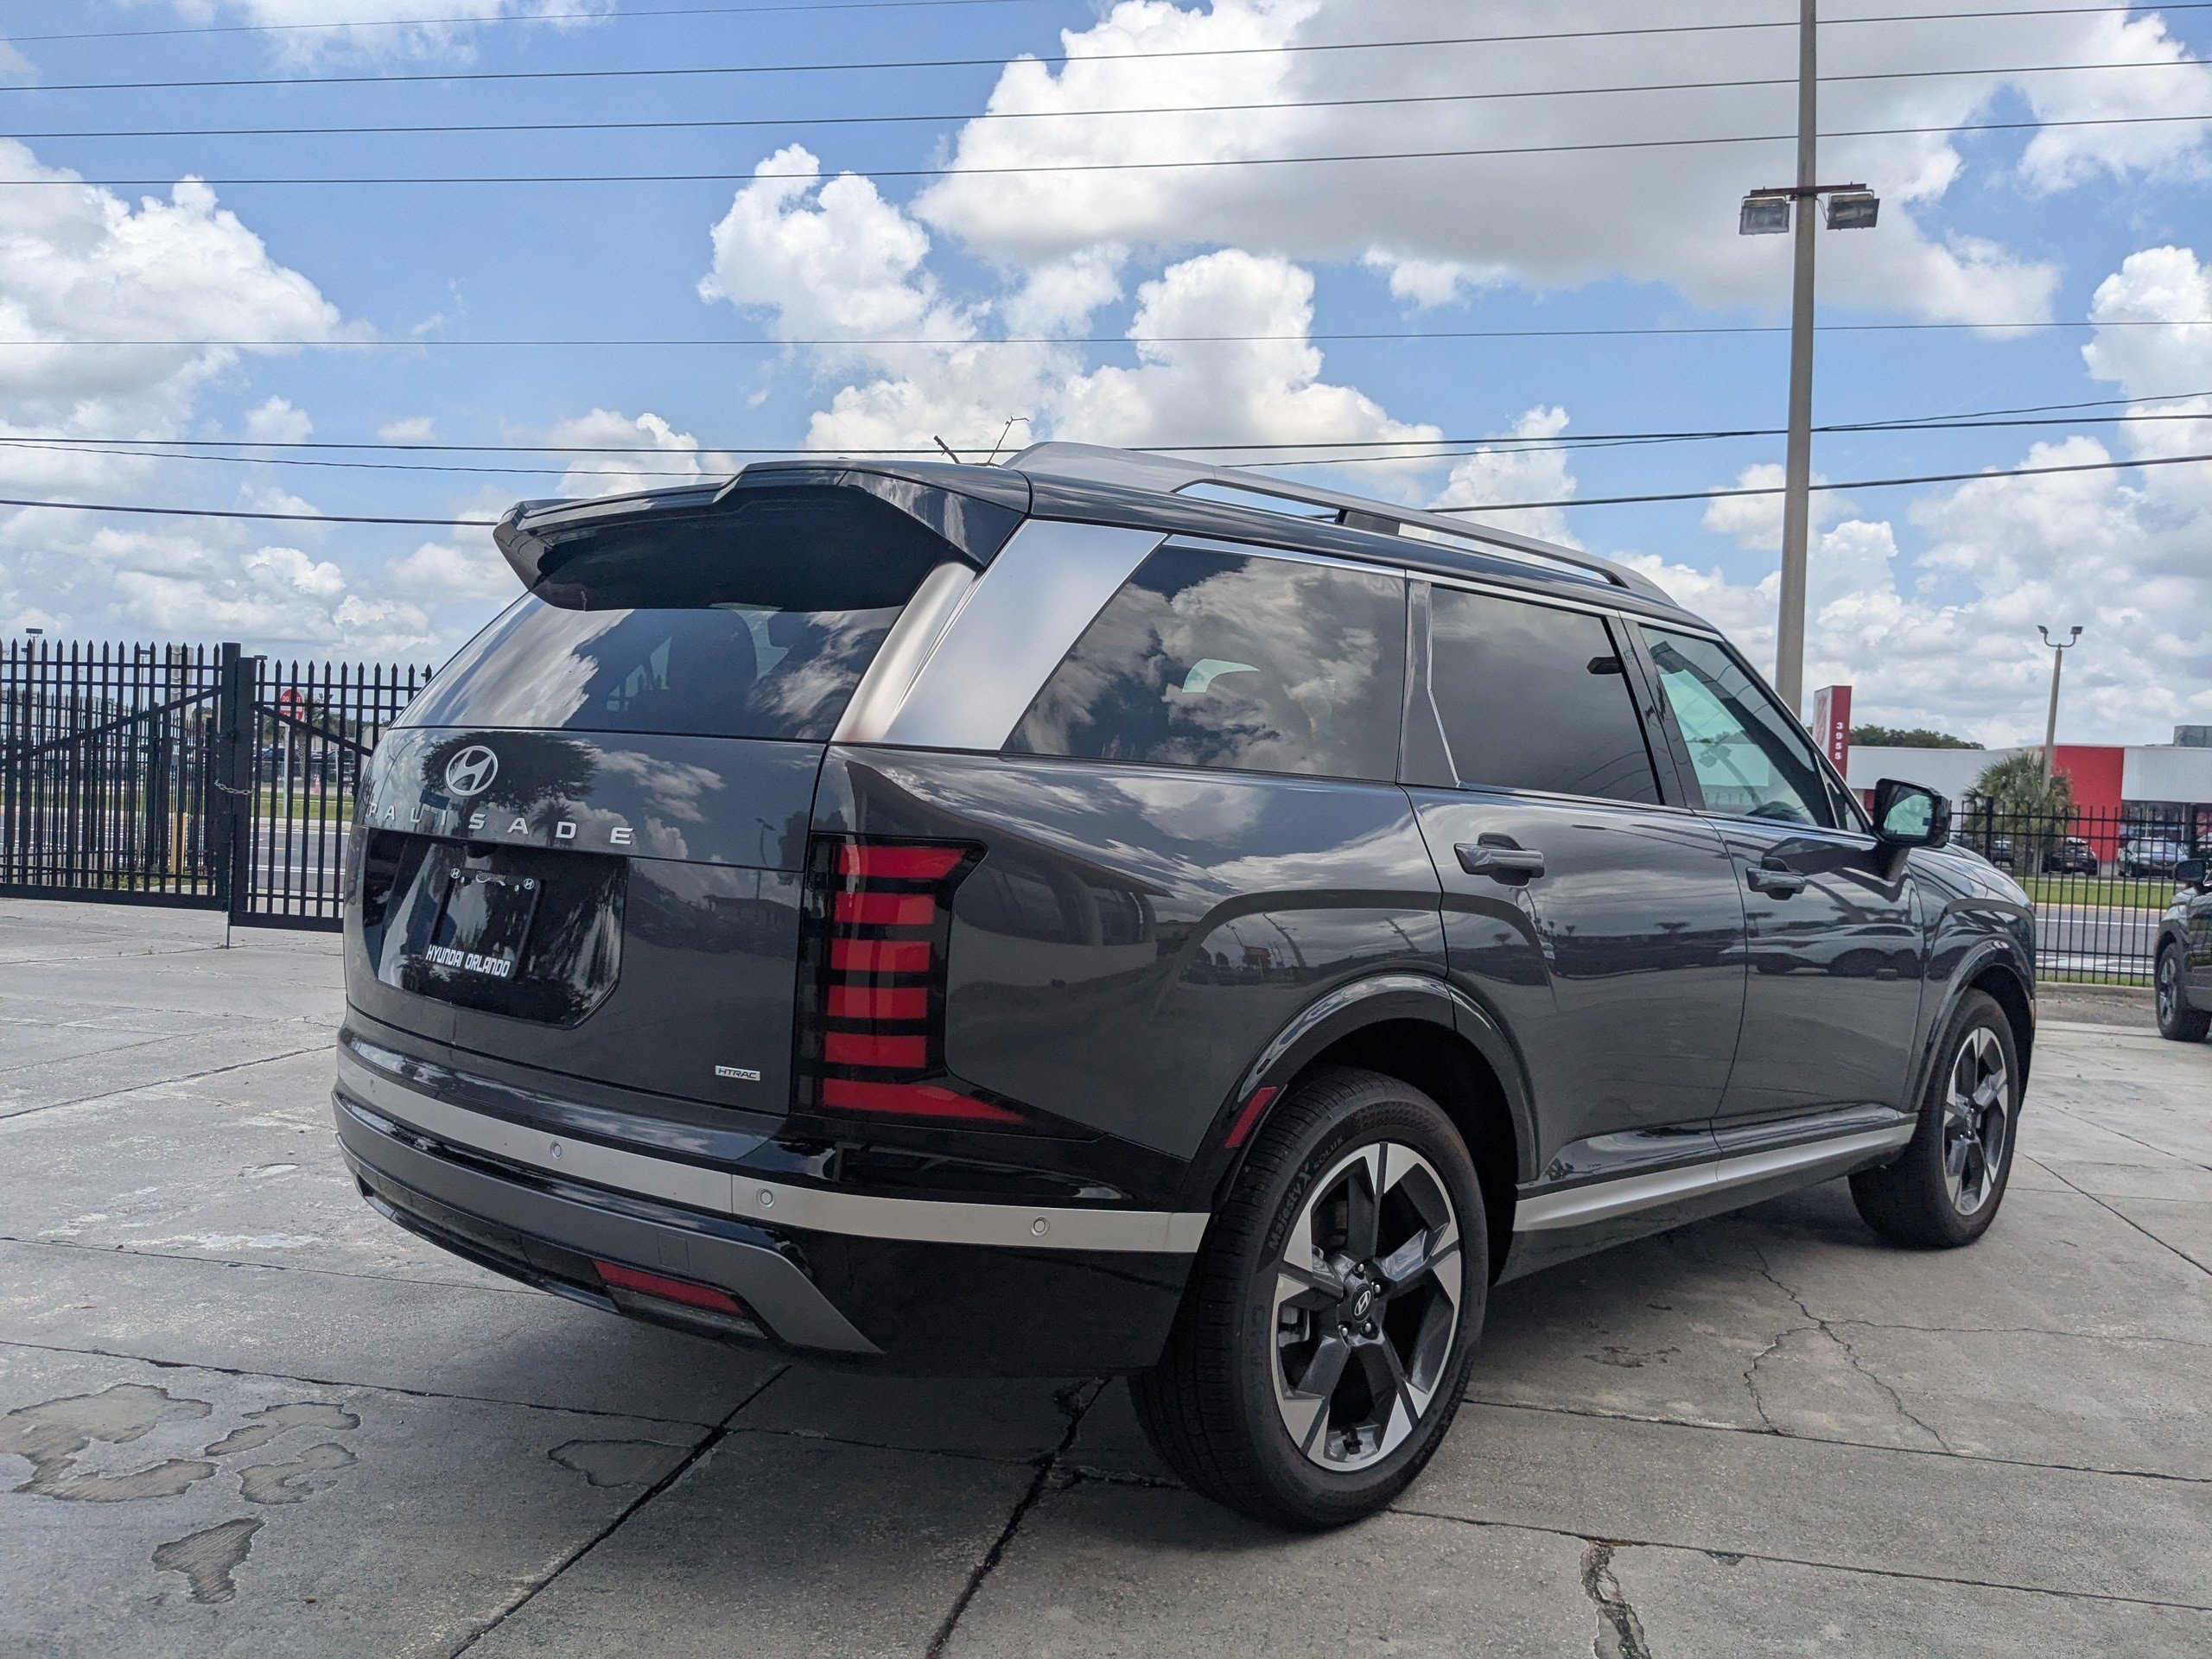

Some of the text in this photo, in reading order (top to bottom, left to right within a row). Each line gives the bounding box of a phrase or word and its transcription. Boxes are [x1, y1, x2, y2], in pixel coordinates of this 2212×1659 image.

[1834, 722, 1843, 760] 3955
[426, 944, 511, 977] HYUNDAI ORLANDO
[719, 1068, 757, 1079] HTRAC
